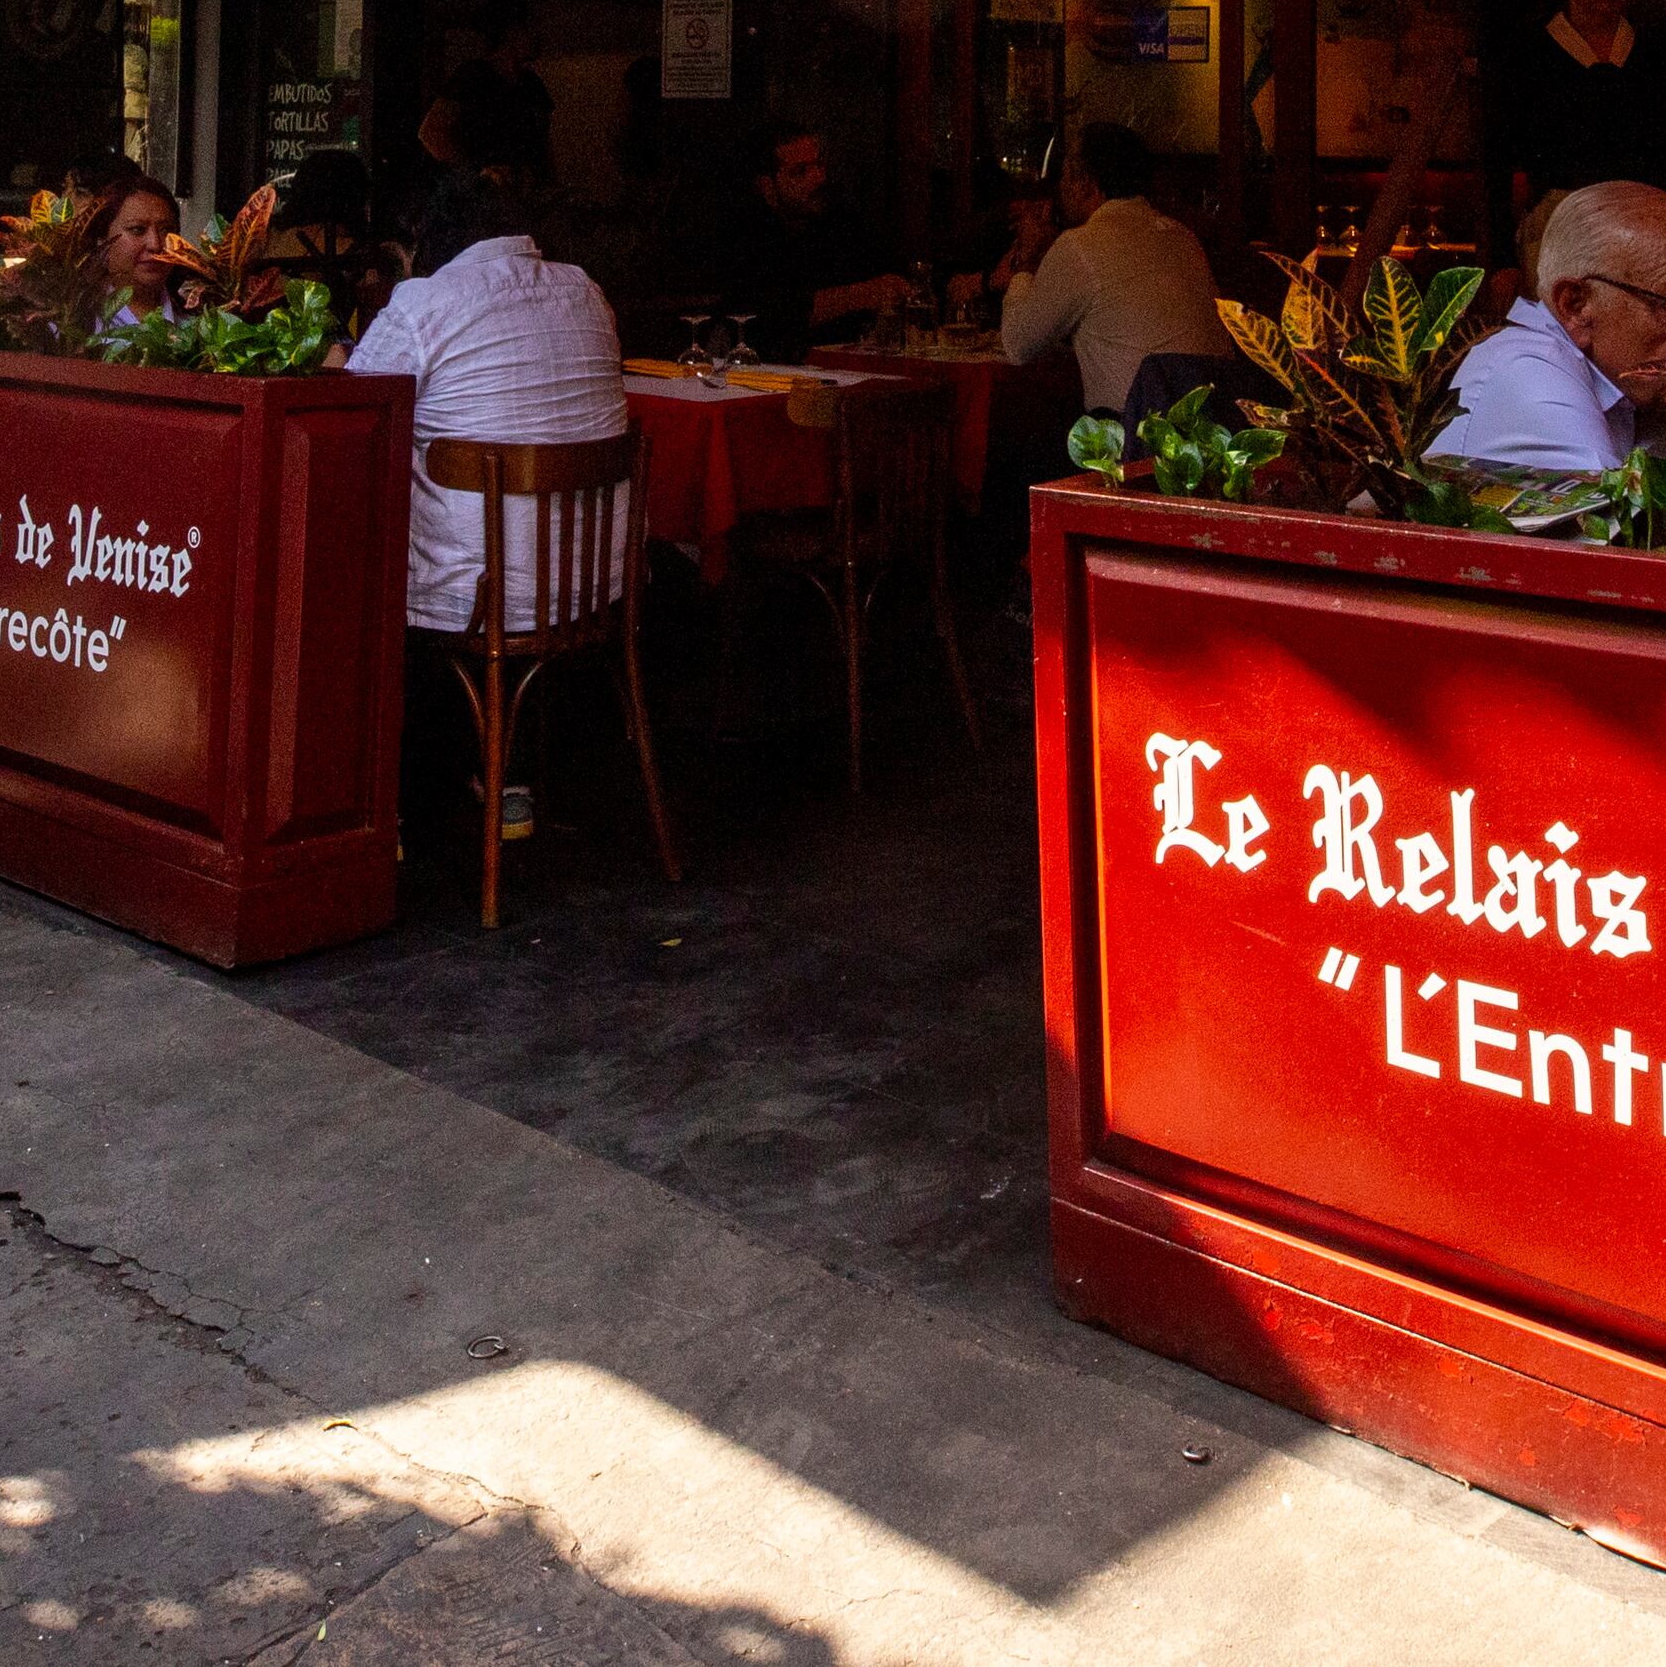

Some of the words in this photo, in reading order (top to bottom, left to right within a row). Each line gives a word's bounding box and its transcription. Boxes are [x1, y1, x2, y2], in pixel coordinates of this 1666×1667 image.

[1137, 42, 1165, 55] VISA
[267, 82, 334, 105] EMBUTIDOS
[267, 110, 330, 133] TORTILLAS
[264, 138, 306, 162] PAPAS
[14, 493, 55, 570] de
[1144, 731, 1271, 873] Le
[1301, 763, 1653, 959] Relais
